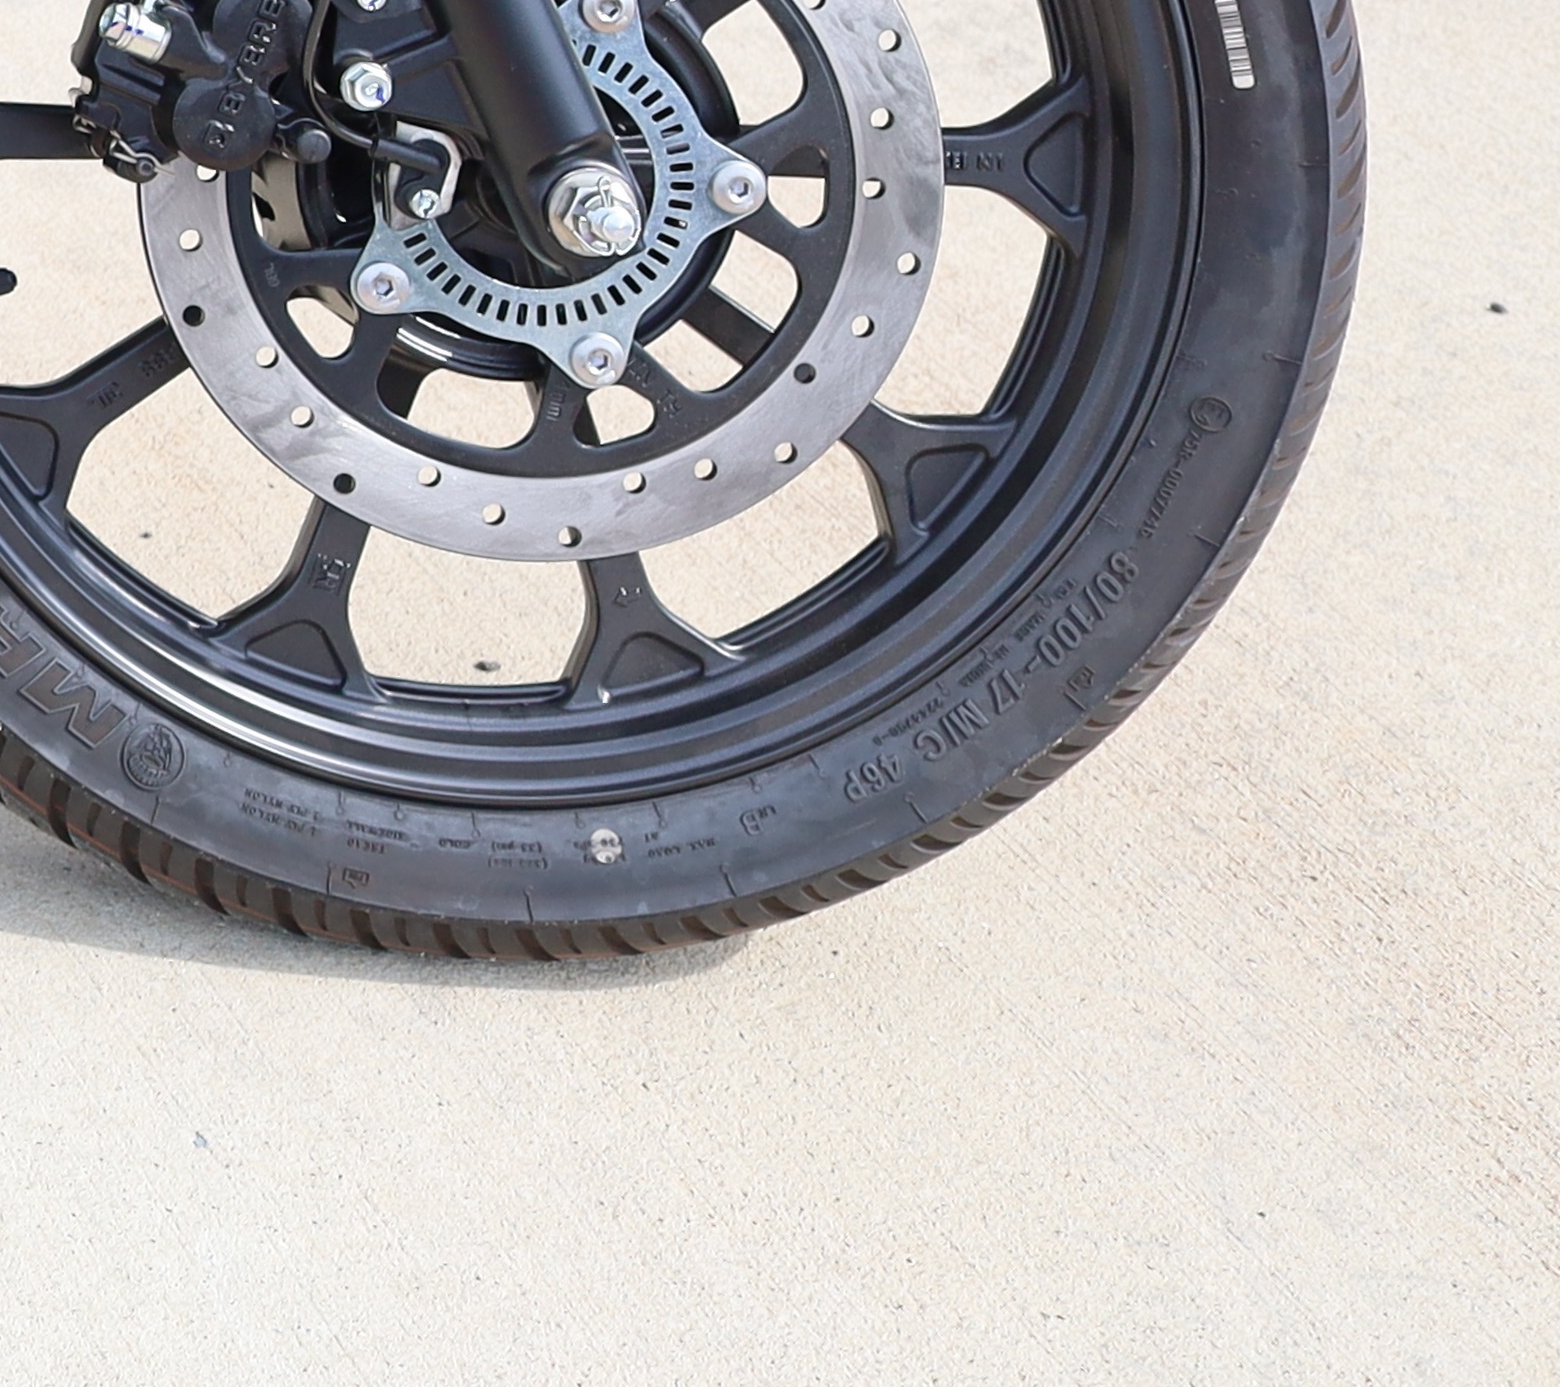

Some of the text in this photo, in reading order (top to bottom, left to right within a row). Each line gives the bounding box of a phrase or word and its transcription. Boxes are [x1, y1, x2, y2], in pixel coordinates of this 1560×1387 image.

[987, 549, 1142, 715] 80/100-17
[920, 695, 989, 765] M/C
[841, 752, 904, 805] 46P
